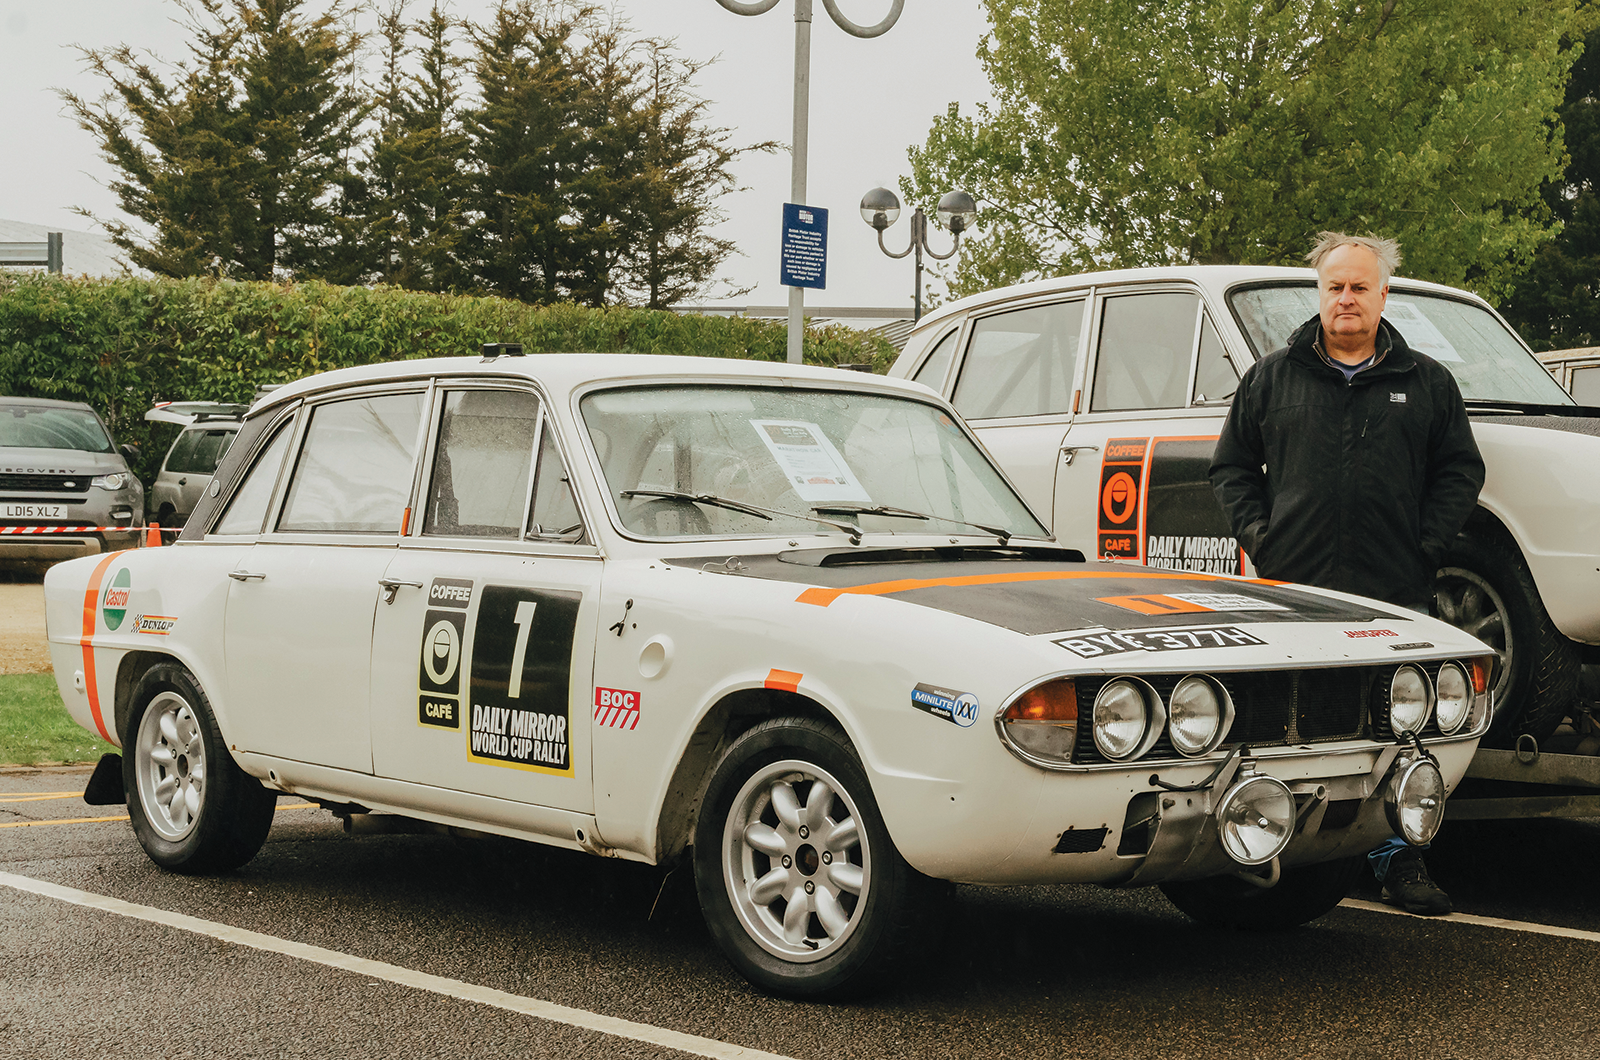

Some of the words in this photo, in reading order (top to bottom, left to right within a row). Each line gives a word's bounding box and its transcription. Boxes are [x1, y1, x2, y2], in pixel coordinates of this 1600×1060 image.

[1106, 445, 1146, 456] COFFEE
[7, 506, 33, 516] LD15
[37, 506, 60, 517] XLZ
[1105, 538, 1131, 550] CAFÉ
[1148, 536, 1184, 558] DAILY
[1184, 537, 1237, 559] MIRROR
[1184, 559, 1205, 572] CUP
[1206, 560, 1238, 575] RALLY
[106, 588, 131, 606] Castrol
[430, 585, 471, 602] COFFEE
[142, 620, 174, 630] DUNLOP
[1146, 628, 1262, 649] 377H
[508, 601, 537, 699] 1
[600, 690, 635, 709] BOC
[916, 692, 954, 710] MINILITE
[933, 690, 956, 700] winning
[426, 702, 453, 720] CAFÉ
[930, 707, 951, 716] wheels
[472, 704, 510, 735] DAILY
[510, 709, 566, 743] MIRROR
[472, 731, 509, 756] WORLD
[510, 737, 532, 759] CUP
[533, 740, 566, 764] RALLY
